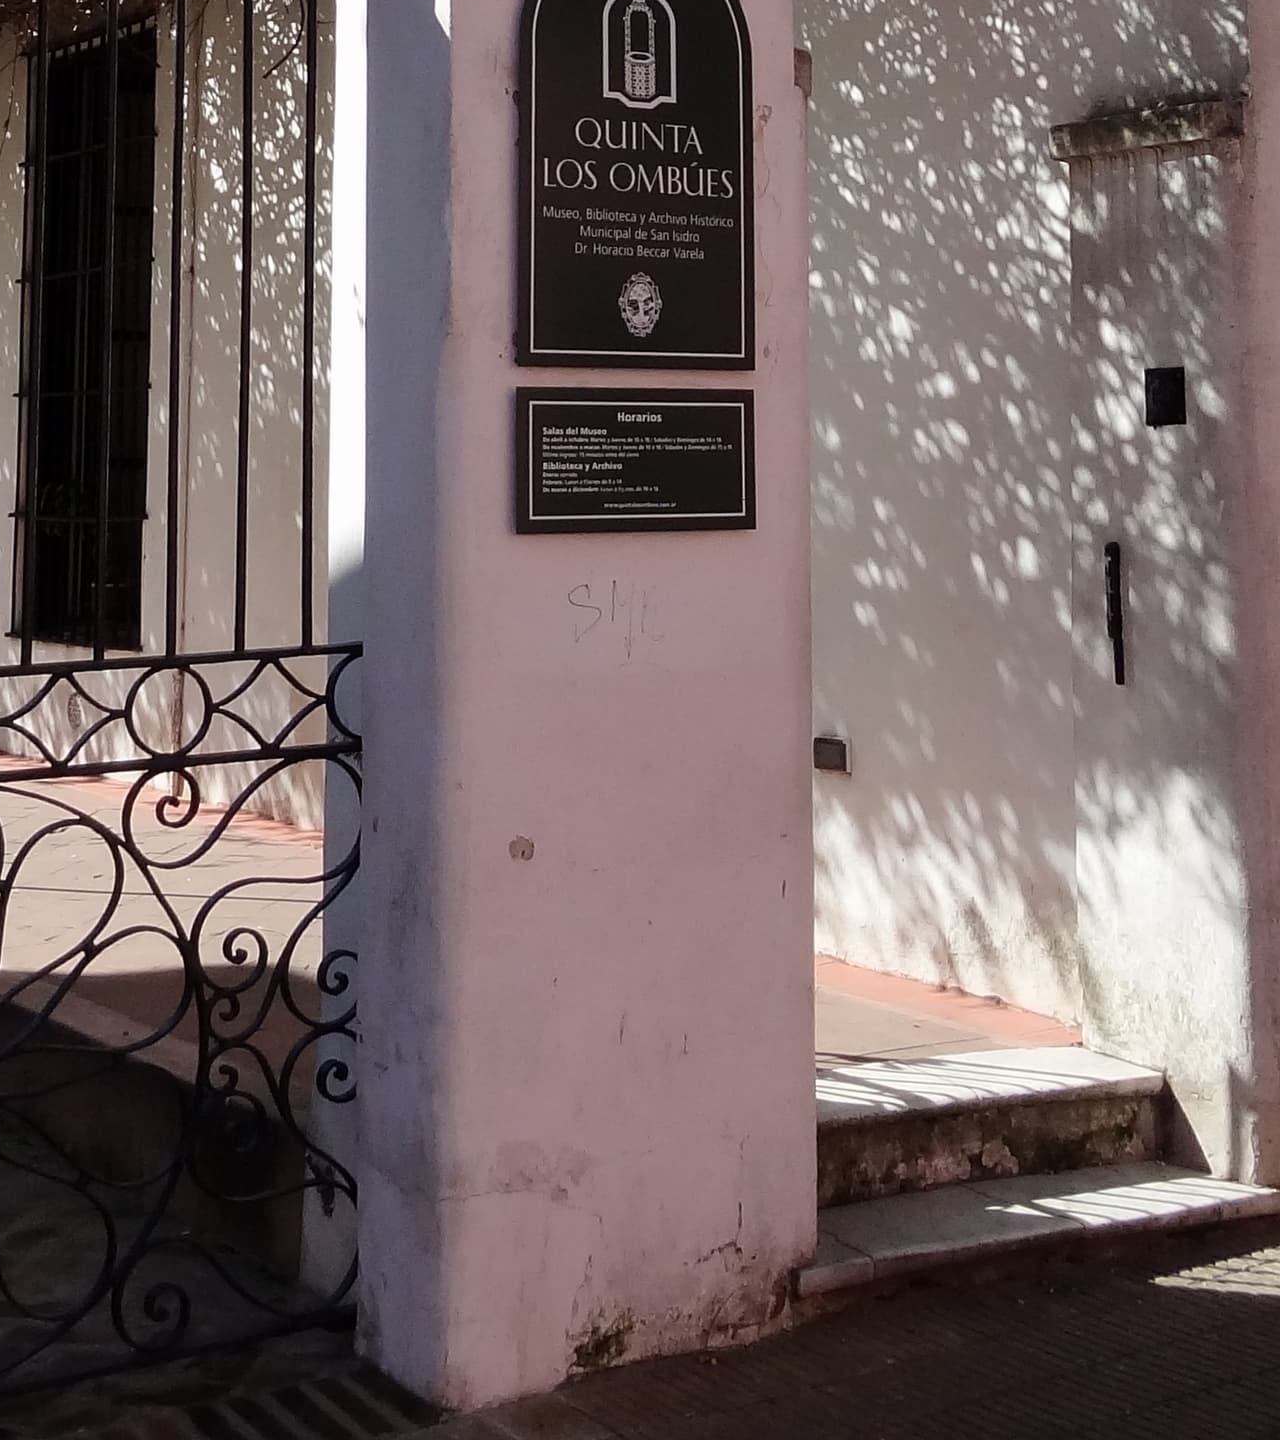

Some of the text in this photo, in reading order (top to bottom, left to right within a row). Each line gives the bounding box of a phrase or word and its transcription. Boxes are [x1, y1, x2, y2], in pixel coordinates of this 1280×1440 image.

[575, 117, 704, 155] QUINTA
[543, 157, 734, 199] LOS OMBÚES
[543, 205, 734, 228] Museo, Biblioteca y Archivo Histórico
[580, 225, 700, 243] Municipal de San Isidro
[593, 243, 634, 257] Horacio
[637, 245, 670, 258] Beccar
[672, 247, 704, 260] Varela
[617, 411, 662, 423] Horarios
[542, 427, 607, 435] Salas del Museo
[542, 461, 623, 472] Biblioteca y Archivo
